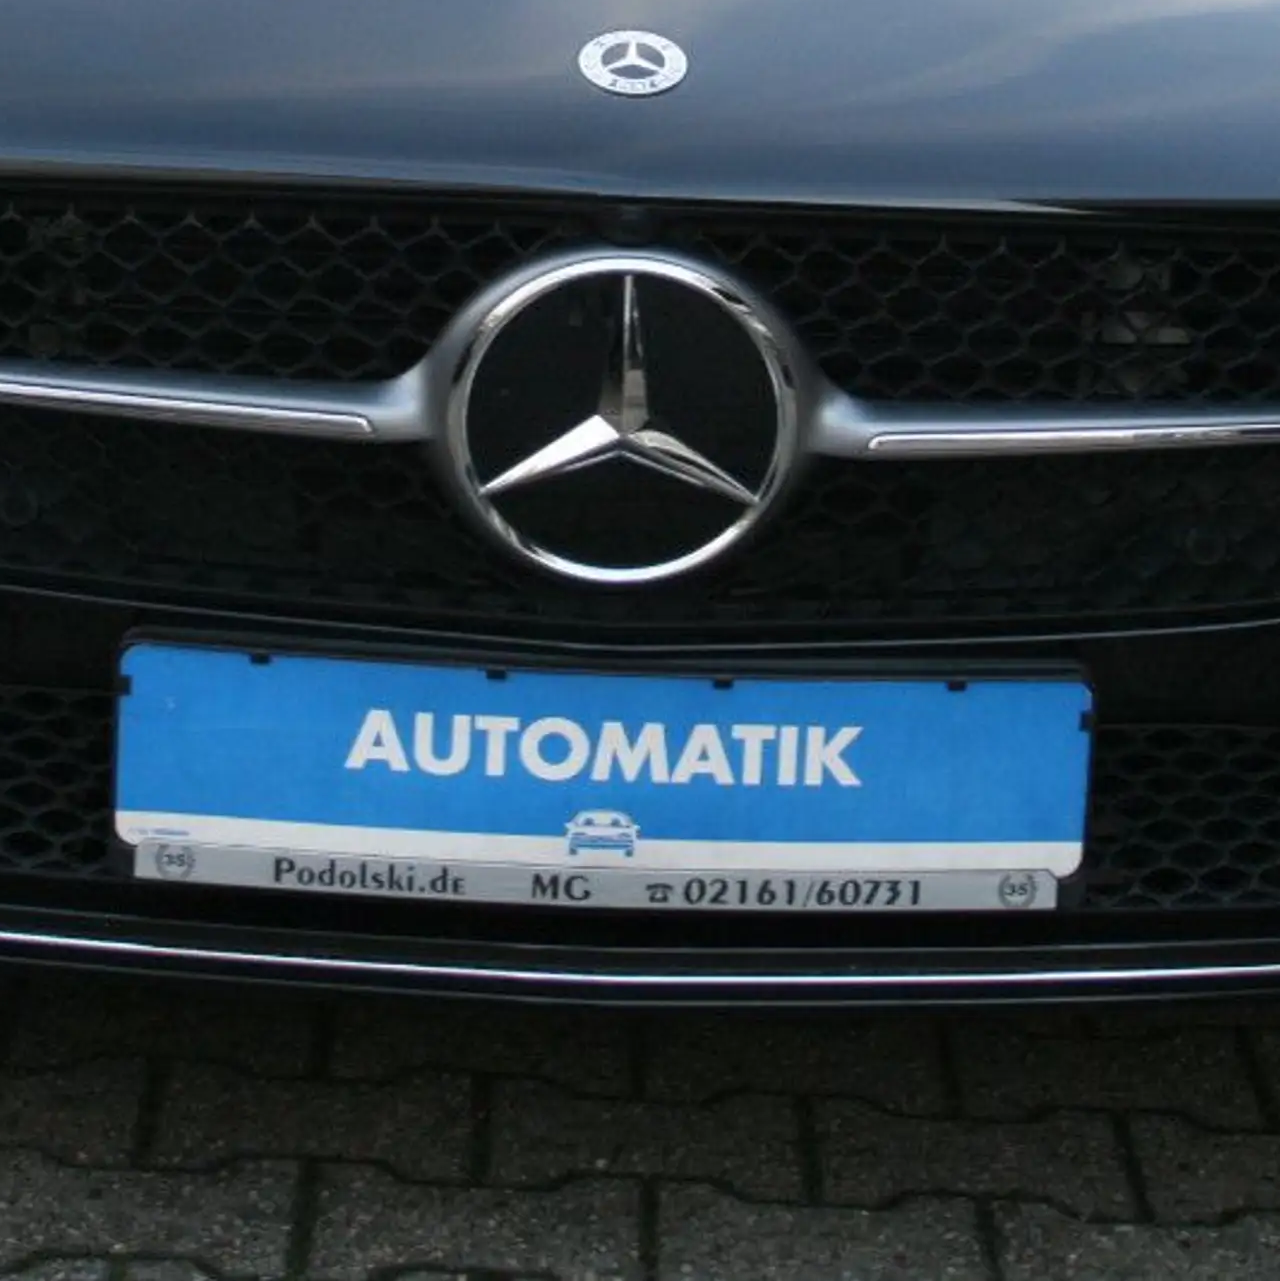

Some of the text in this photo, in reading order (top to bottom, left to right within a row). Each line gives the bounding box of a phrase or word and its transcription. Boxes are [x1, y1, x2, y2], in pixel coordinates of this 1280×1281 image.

[345, 707, 864, 788] AUTOMATIK
[531, 872, 592, 901] MG
[683, 878, 921, 907] 02161/60731
